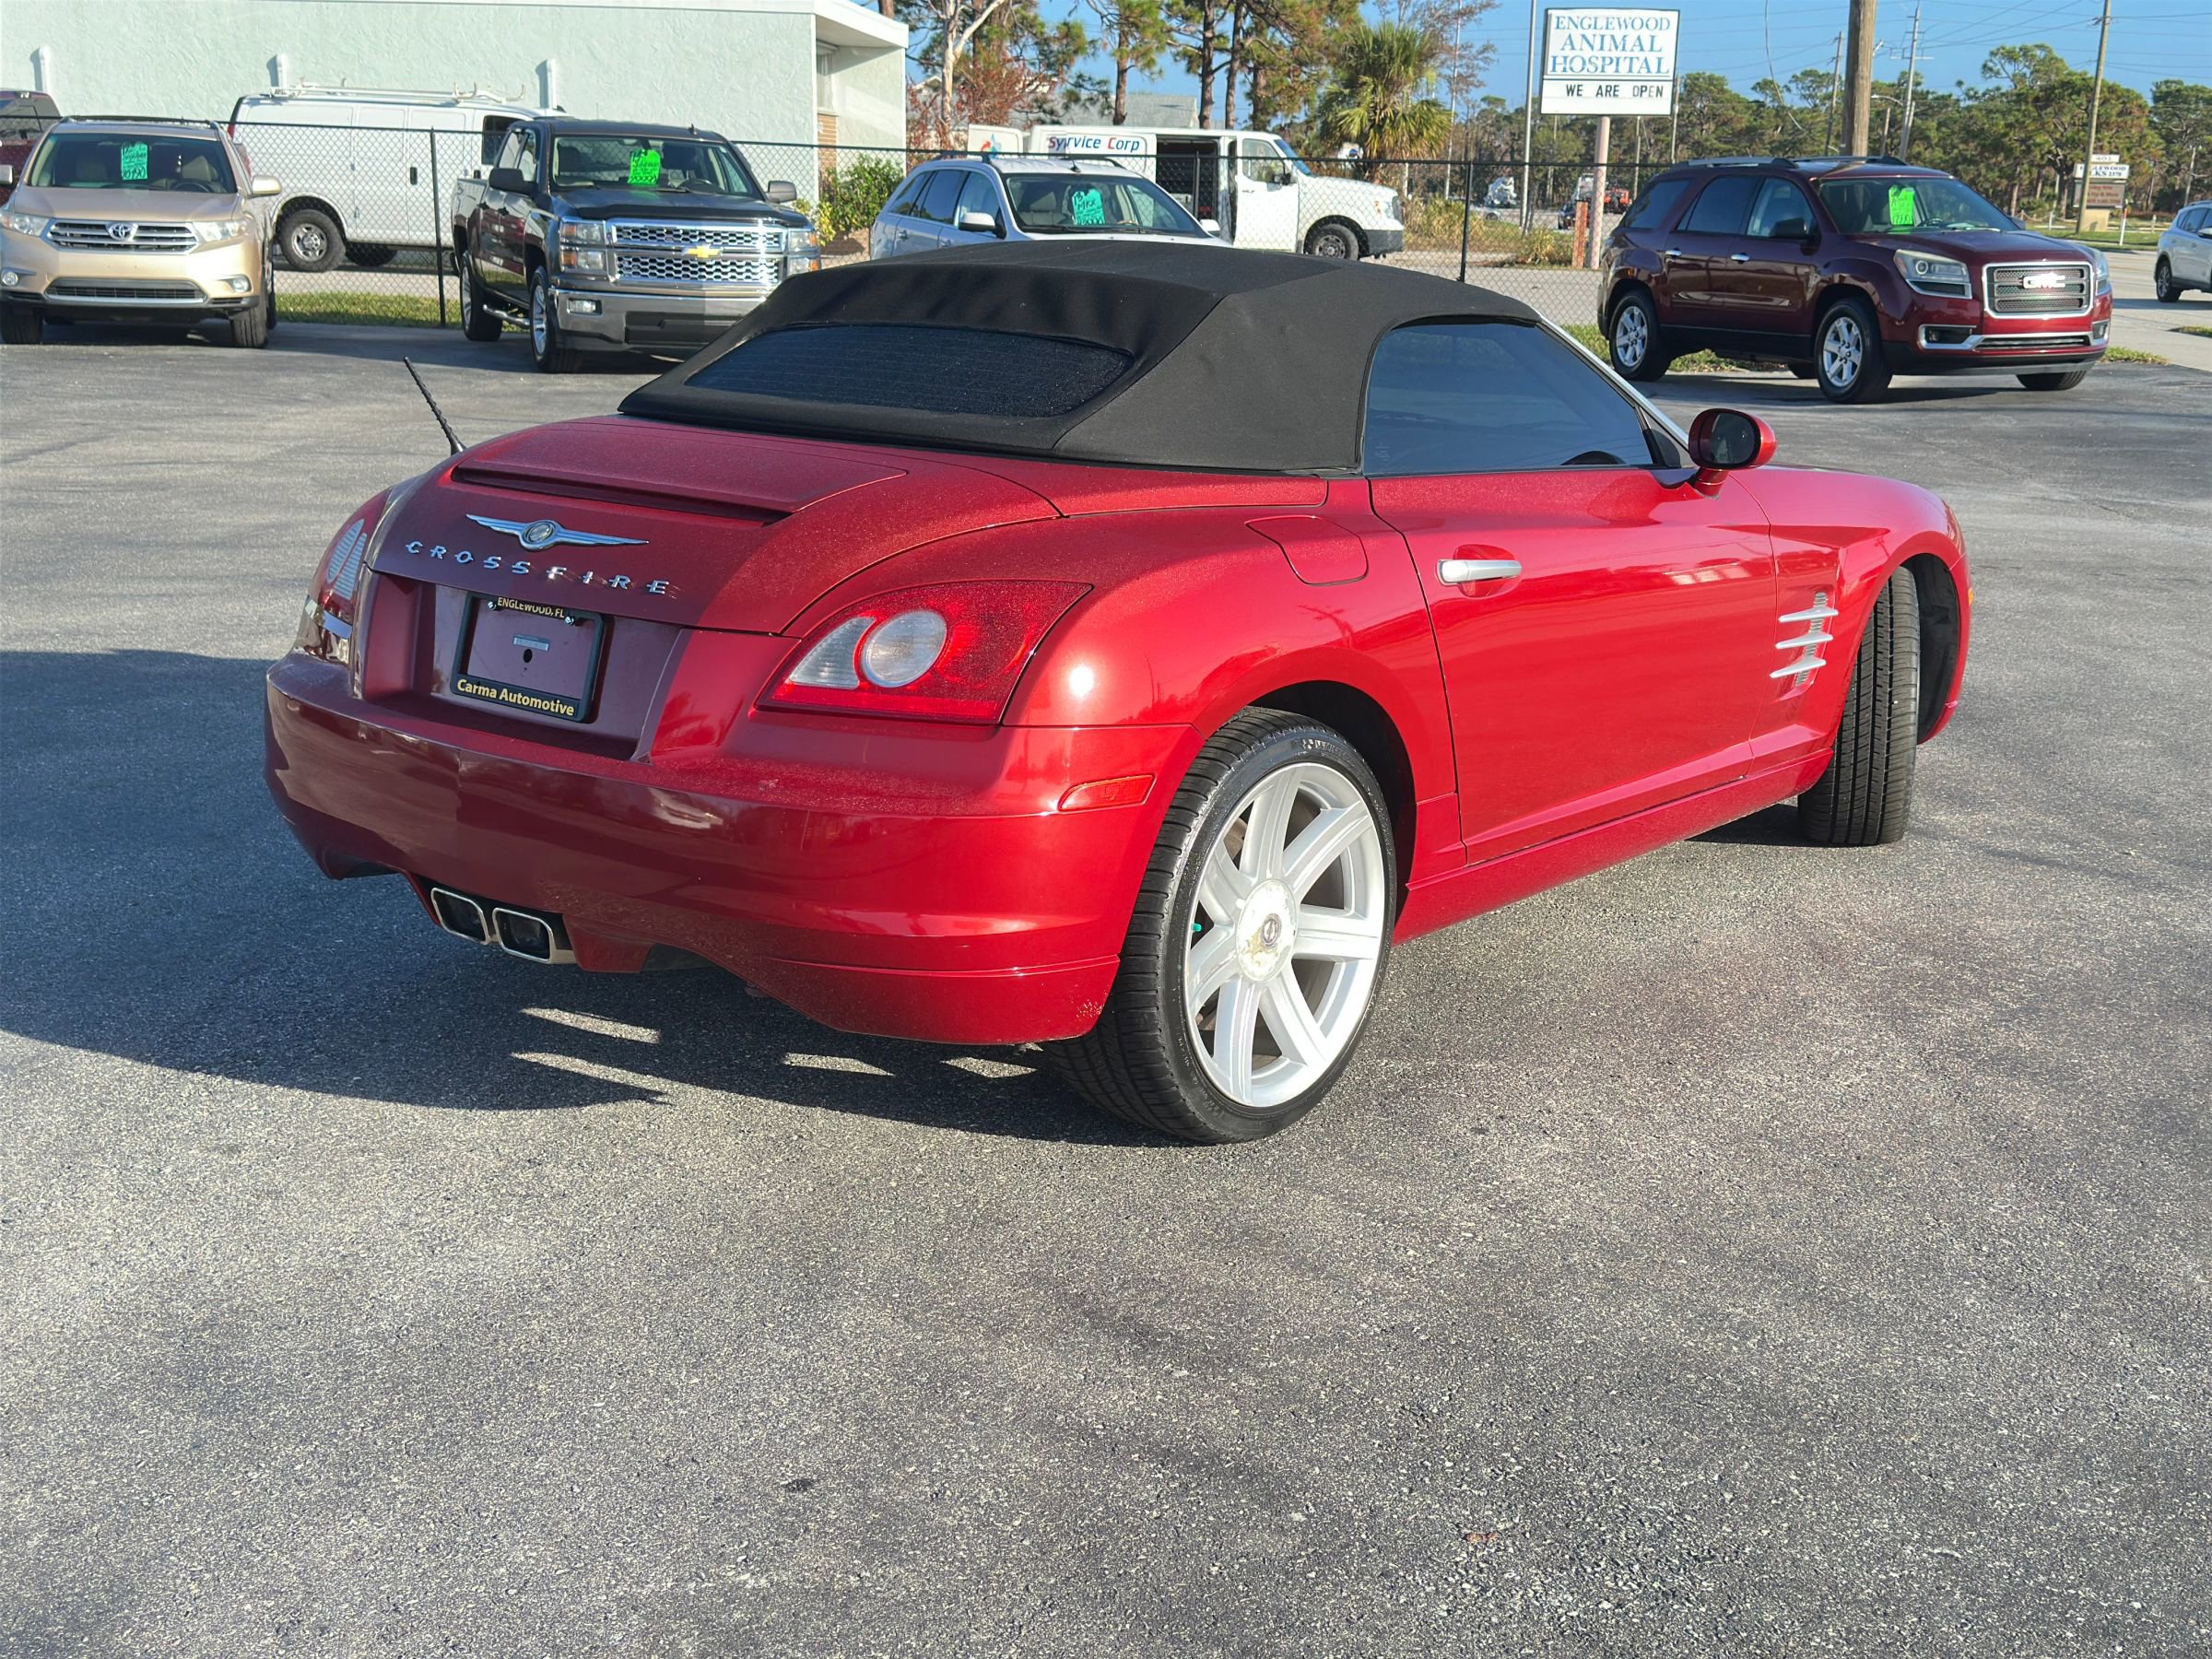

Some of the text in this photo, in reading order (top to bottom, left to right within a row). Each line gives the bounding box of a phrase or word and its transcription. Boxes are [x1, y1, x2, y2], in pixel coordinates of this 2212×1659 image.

[1554, 16, 1670, 31] ENGLEWOOD
[1559, 33, 1663, 53] ANIMAL
[1549, 54, 1670, 75] HOSPITAL
[1566, 84, 1664, 98] WE ARE OPEN
[1107, 136, 1140, 153] Corp
[2023, 274, 2065, 288] GMC
[405, 541, 670, 595] CROSSFIRE
[497, 596, 566, 618] ENGLEWOOD, FL
[457, 678, 575, 717] Carma Automotive
